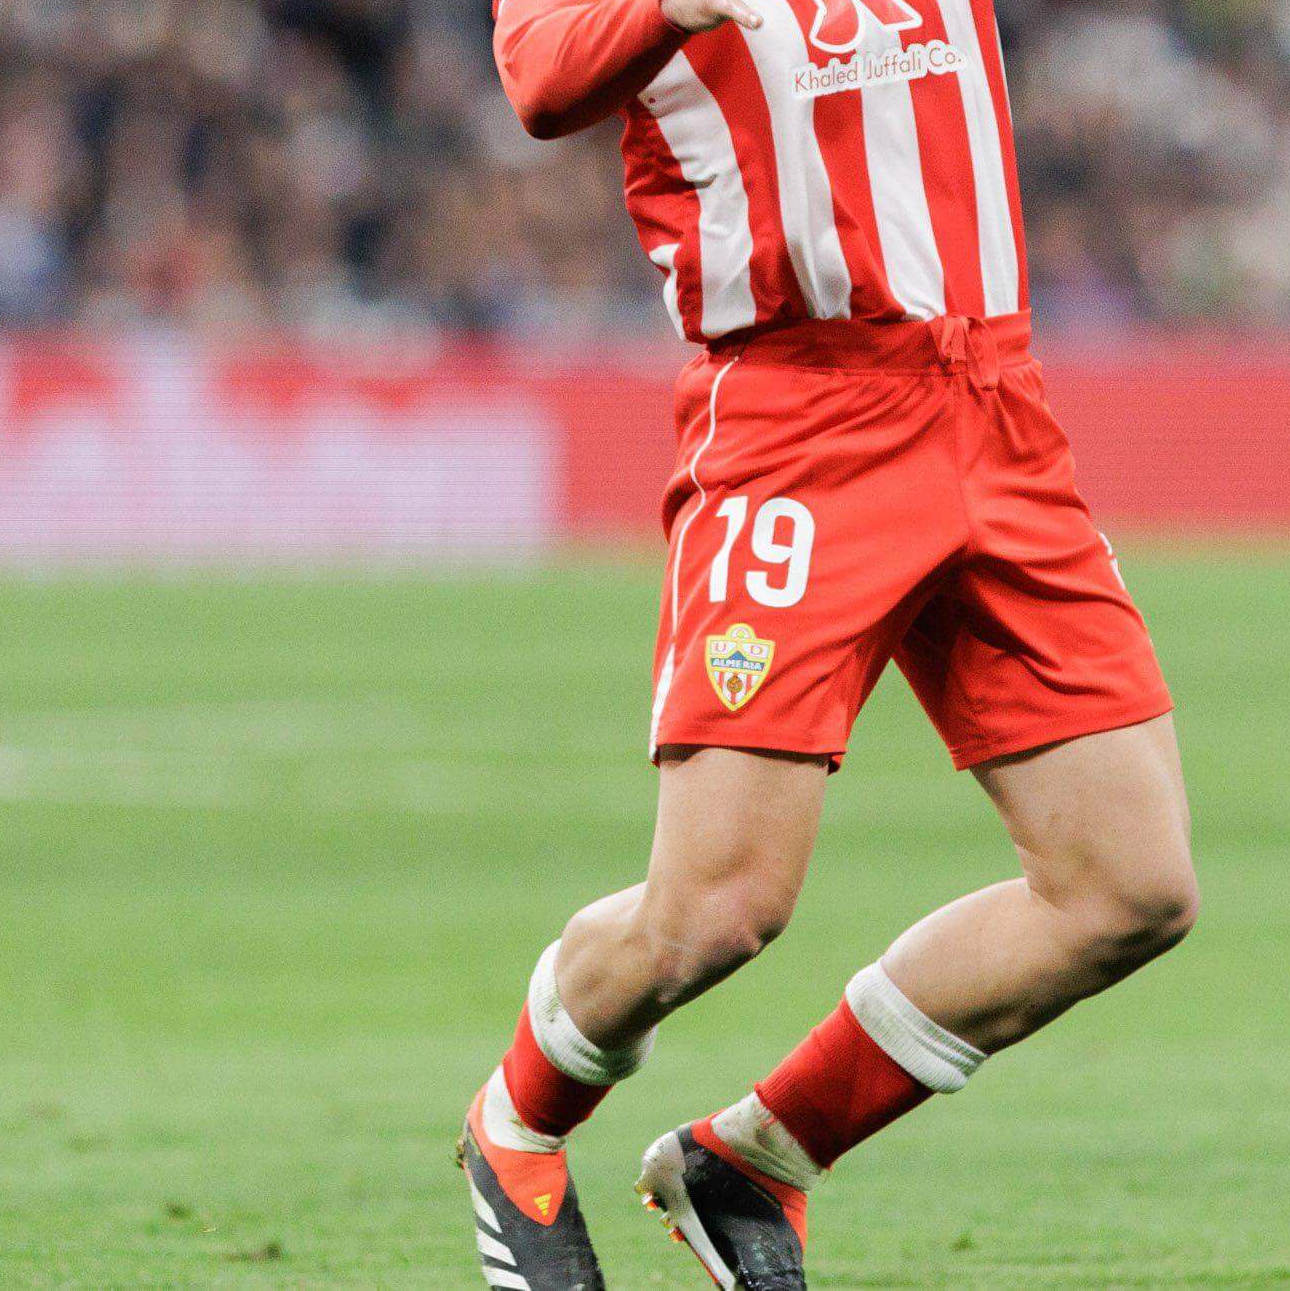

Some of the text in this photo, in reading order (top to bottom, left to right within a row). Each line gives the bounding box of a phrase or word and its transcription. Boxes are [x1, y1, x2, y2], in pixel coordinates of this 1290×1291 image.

[794, 46, 962, 92] Khaled Juffali Co.
[709, 495, 816, 608] 19
[711, 658, 764, 671] ALMERIA
